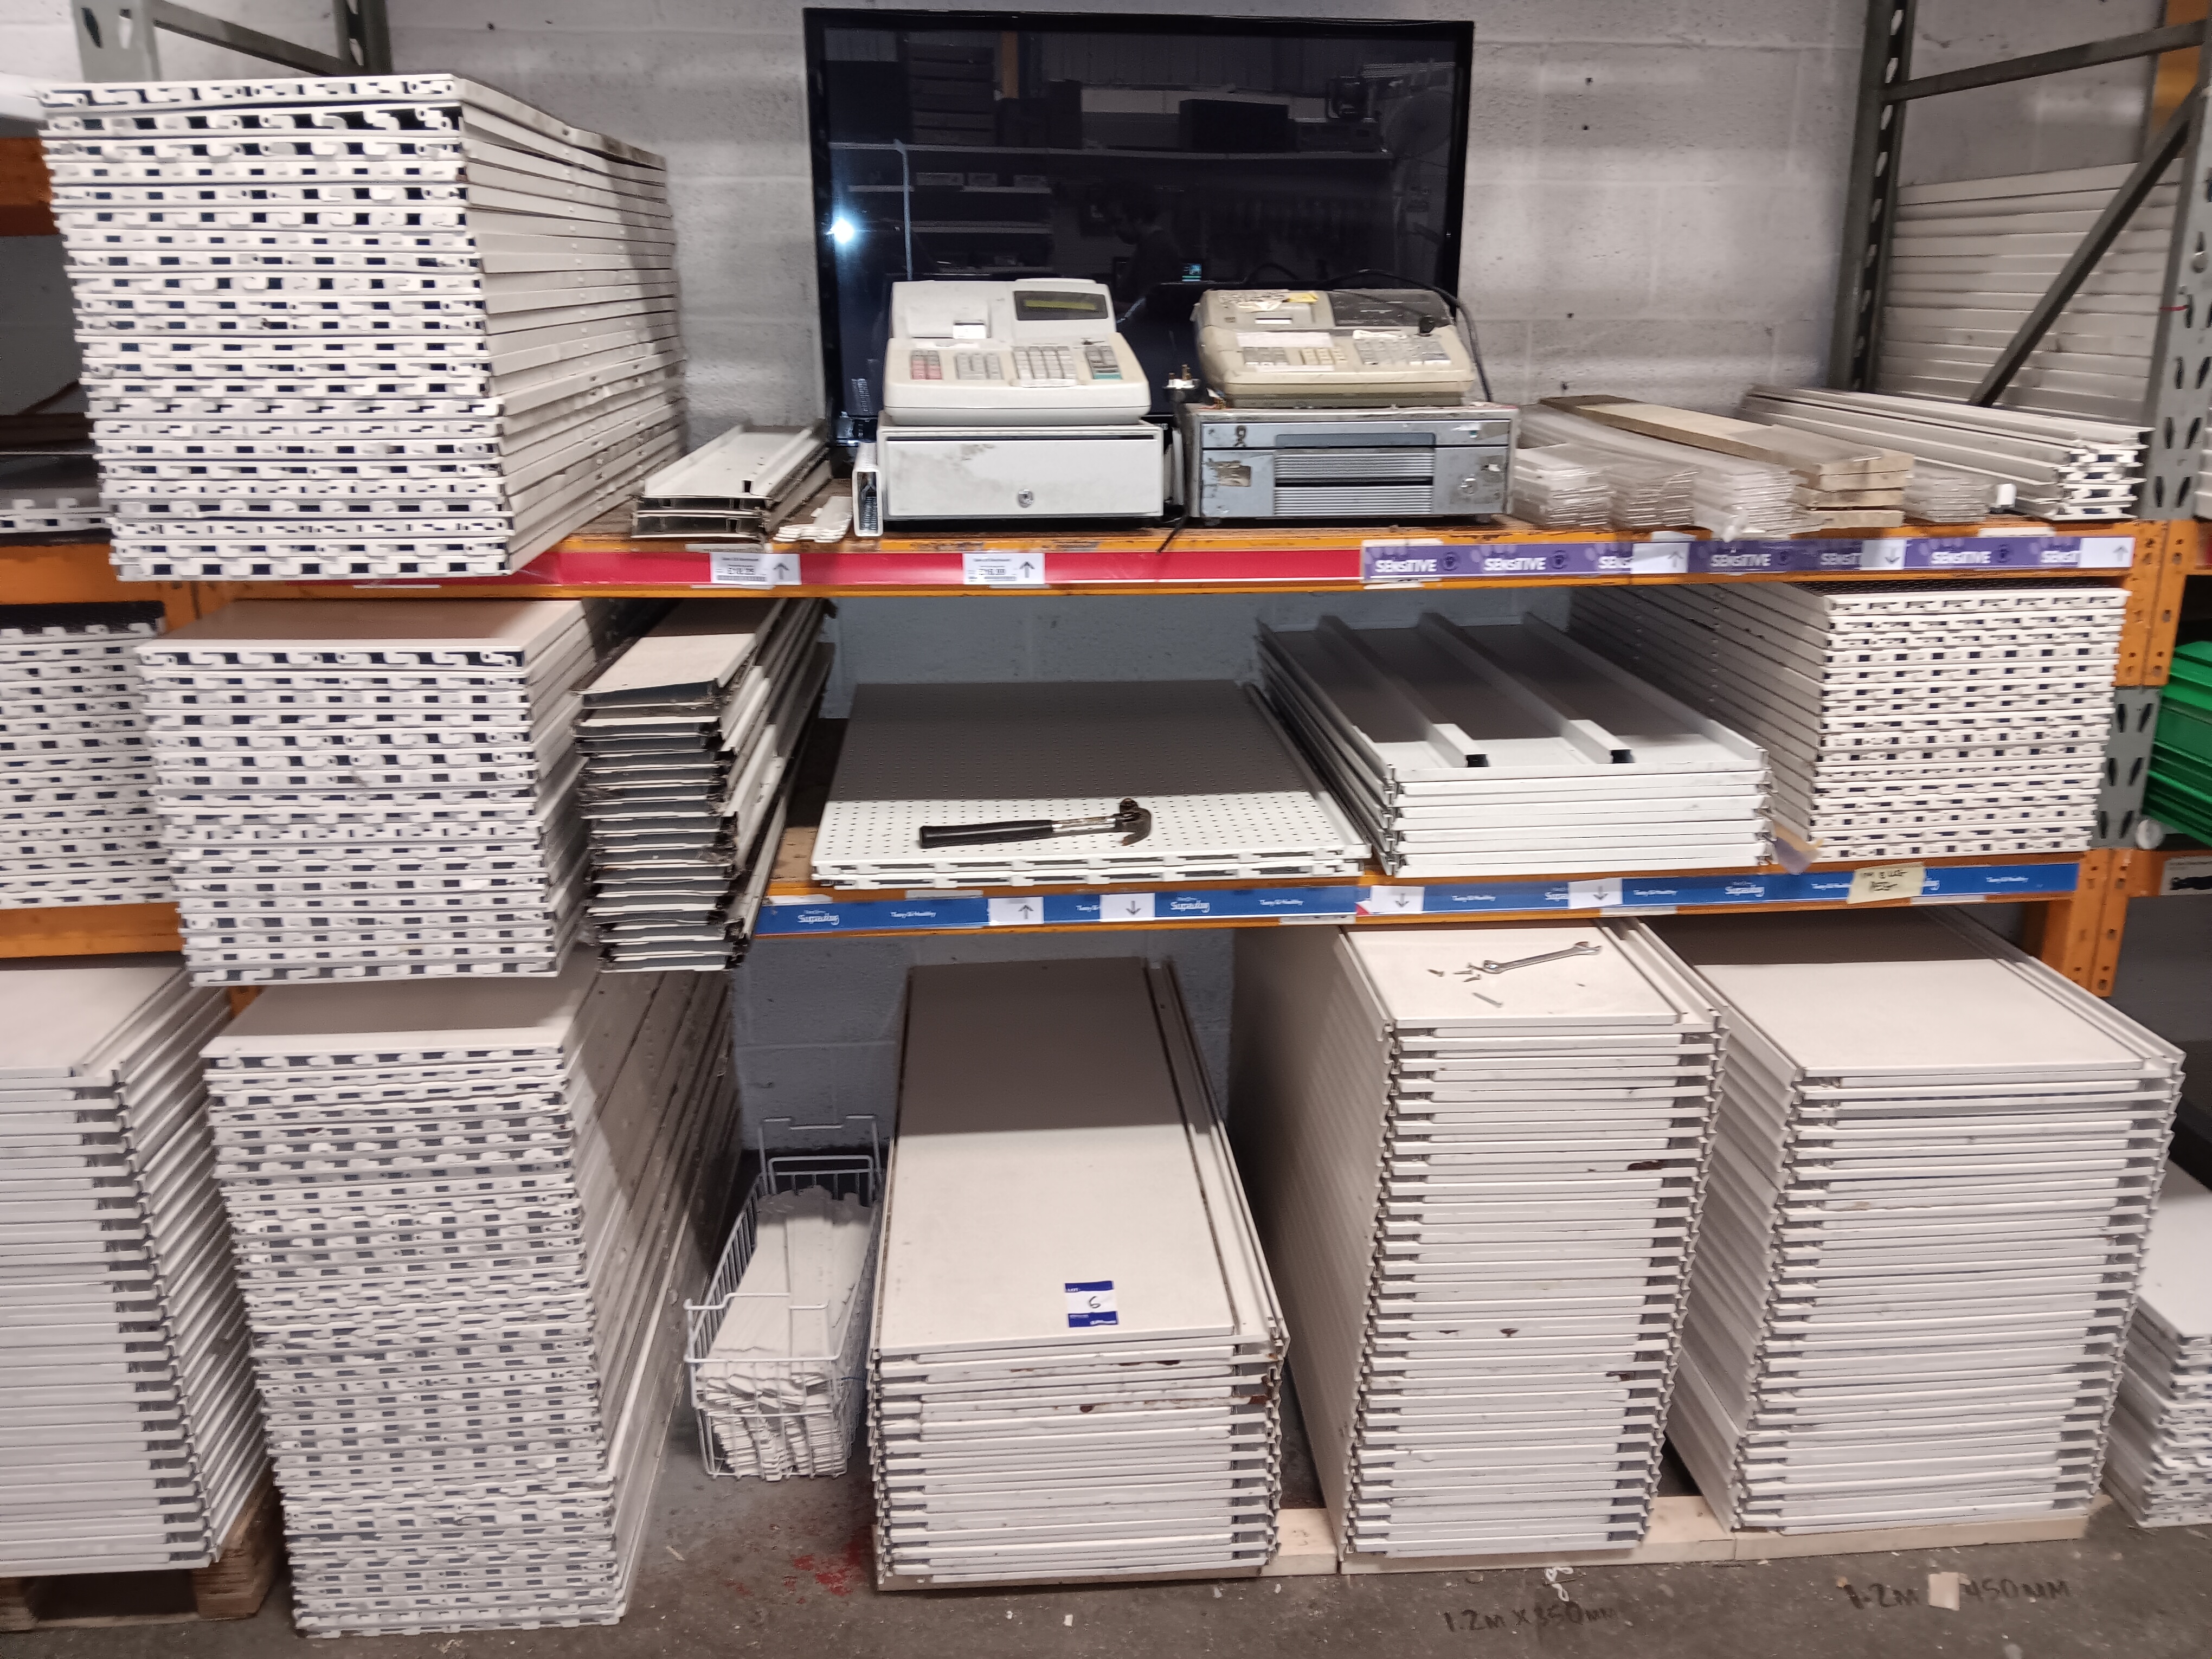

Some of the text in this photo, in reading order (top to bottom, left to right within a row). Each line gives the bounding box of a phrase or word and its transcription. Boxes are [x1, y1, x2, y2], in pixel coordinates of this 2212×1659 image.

[1483, 557, 1547, 571] SENSITIVE
[1709, 554, 1772, 567] SENSITIVE
[1931, 551, 1992, 564] SENSITIVE
[1374, 559, 1437, 573] SENSITIVE
[1089, 1296, 1101, 1309] 6
